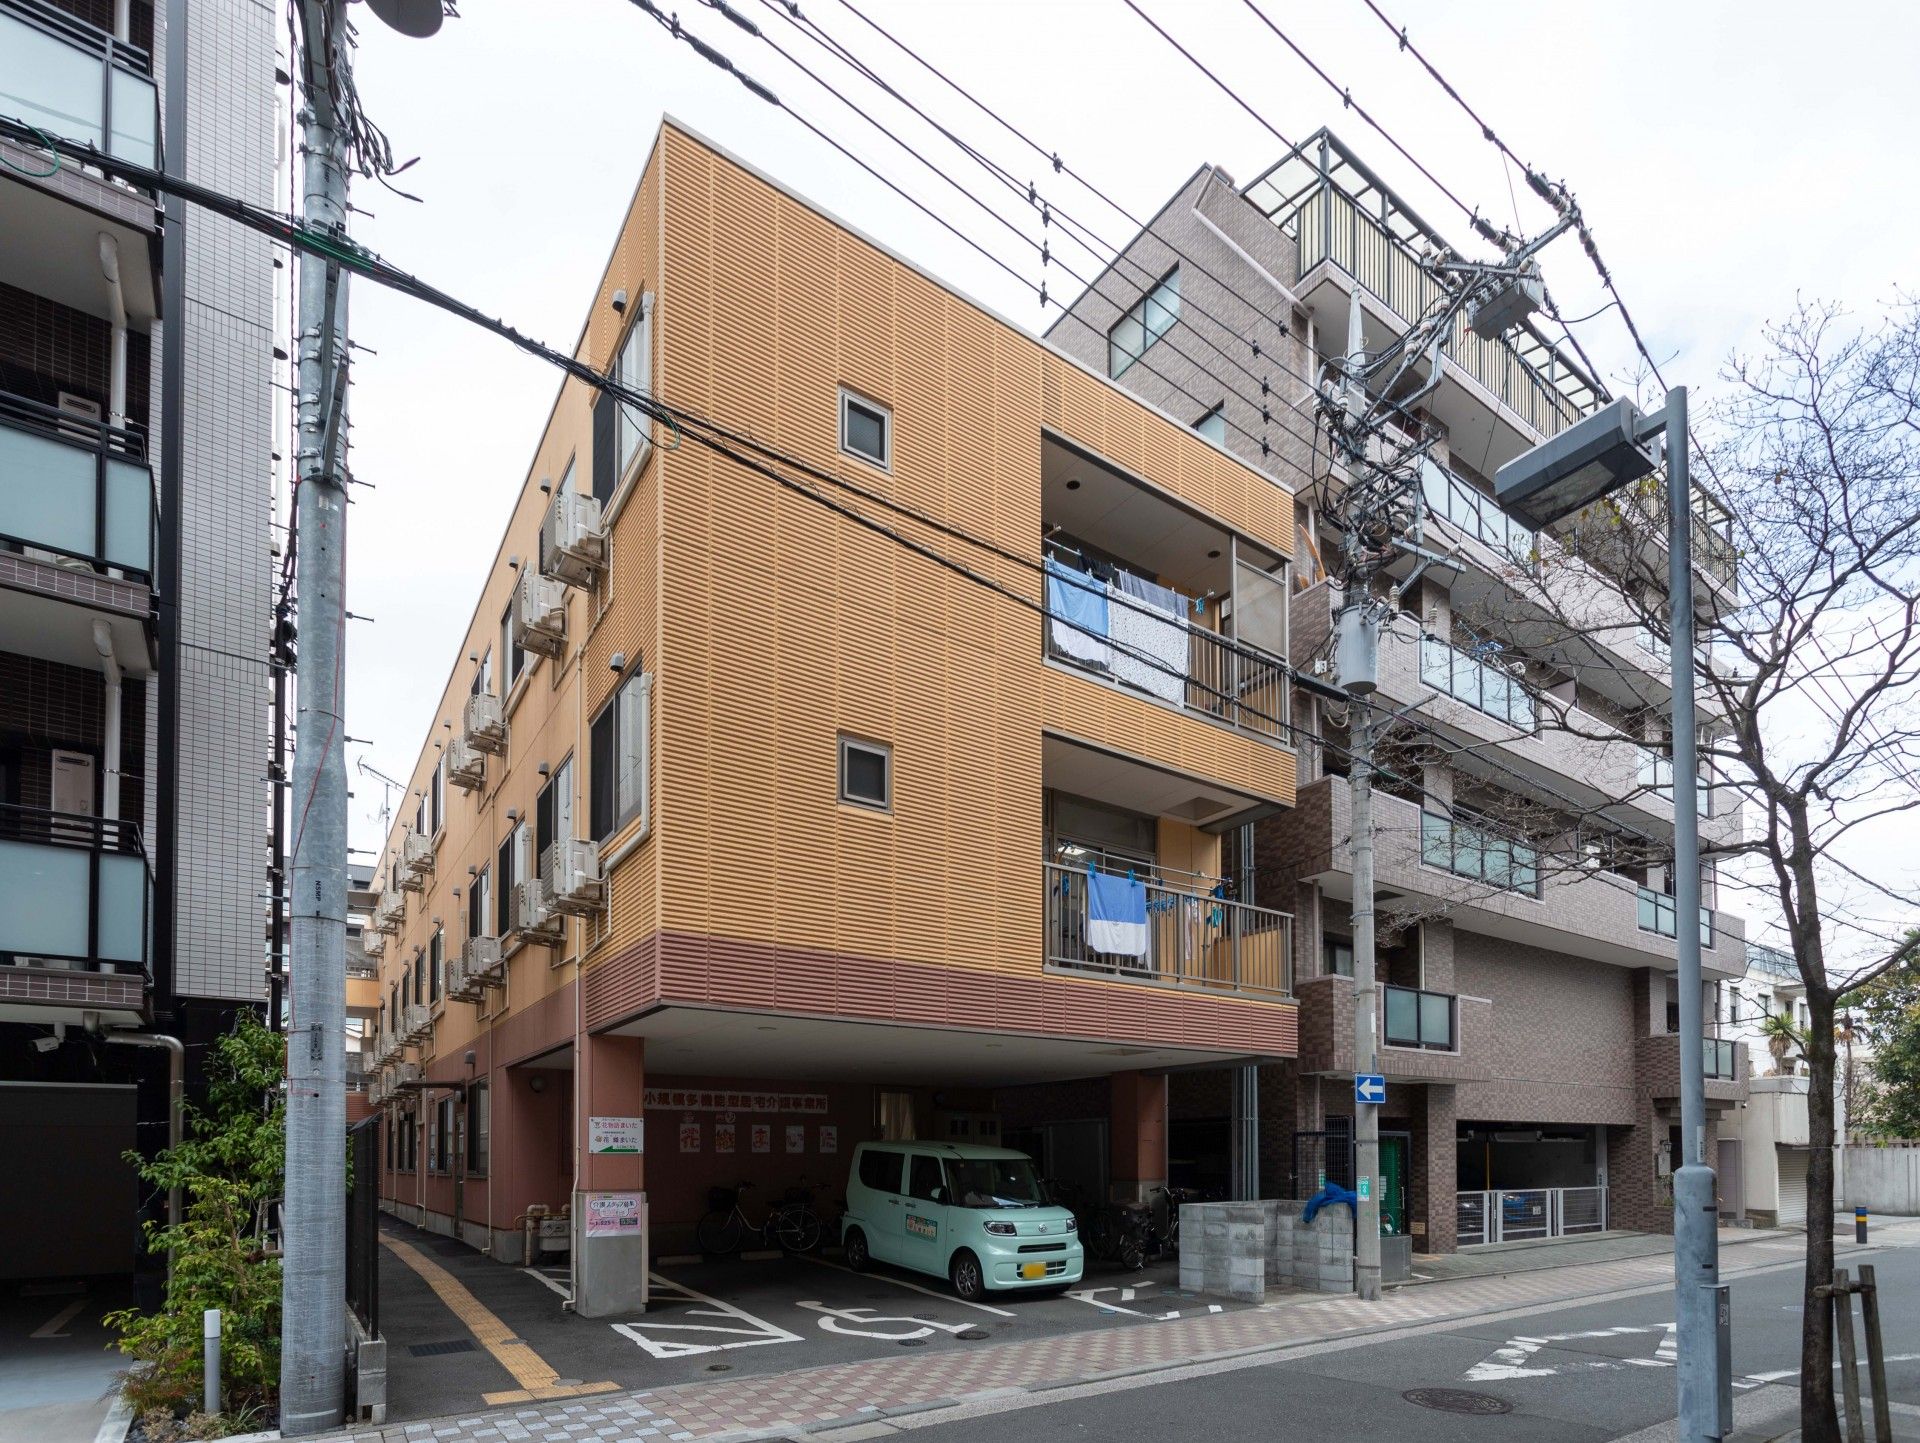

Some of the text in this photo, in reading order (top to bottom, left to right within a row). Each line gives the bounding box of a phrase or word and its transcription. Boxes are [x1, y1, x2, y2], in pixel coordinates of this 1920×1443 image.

[643, 1091, 827, 1110] 小規模多機能型居宅介護事業所
